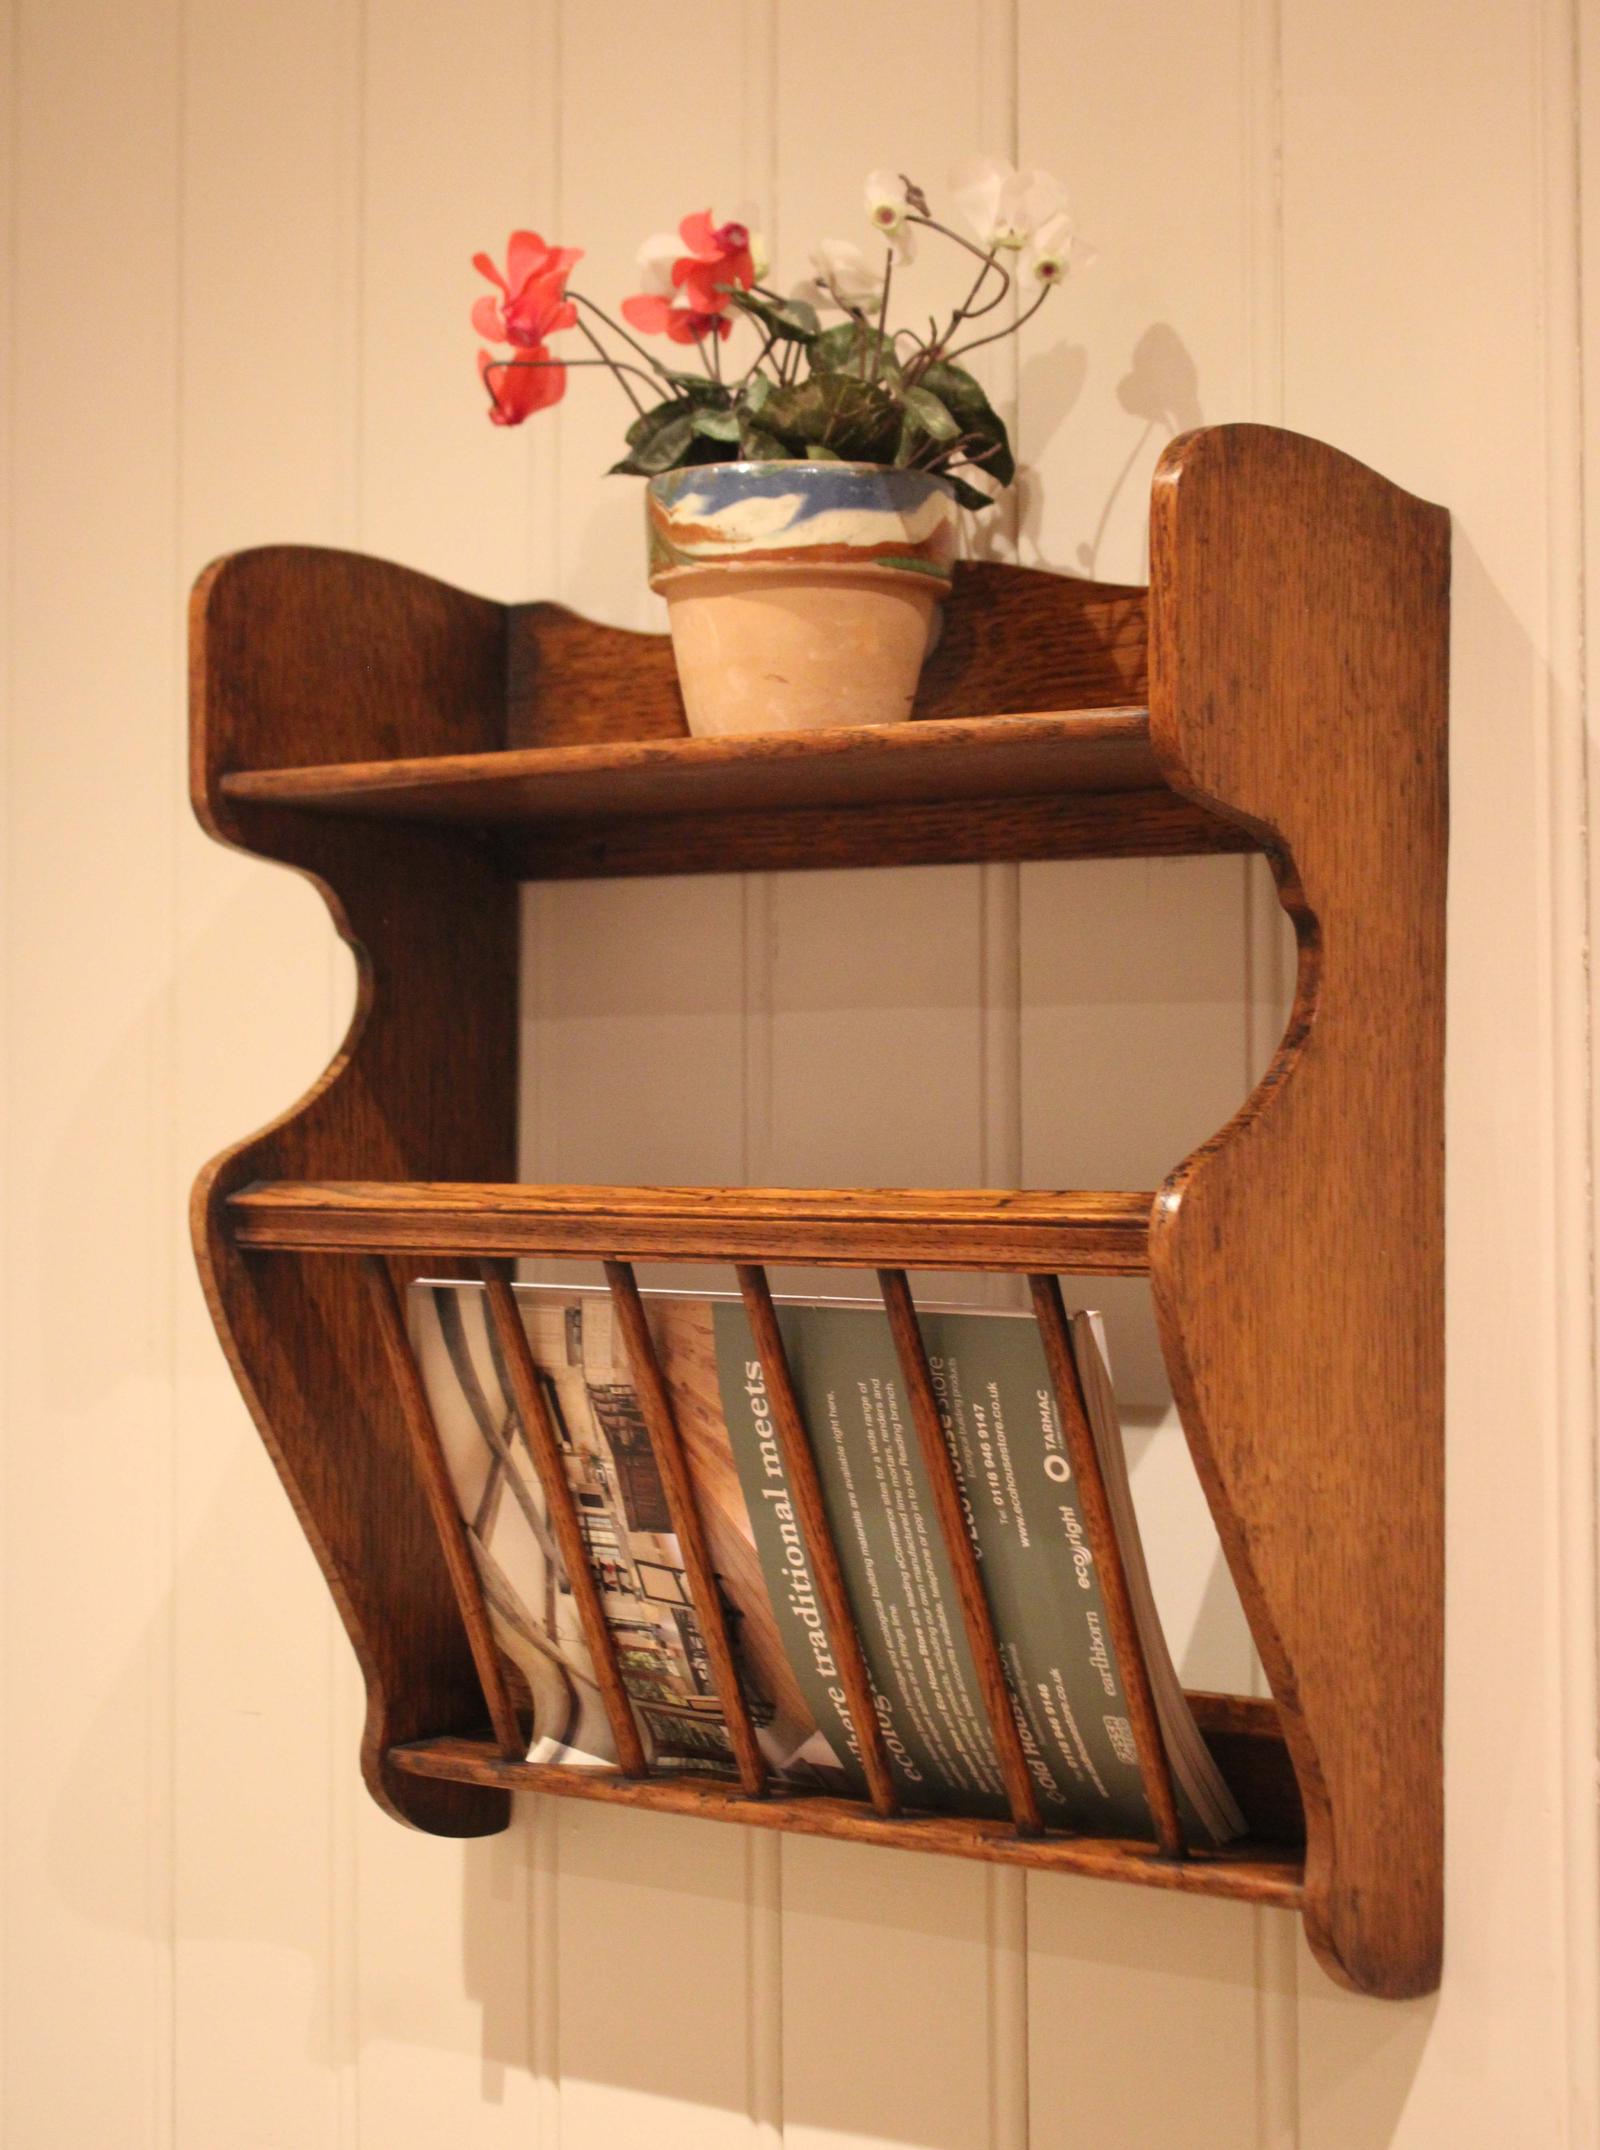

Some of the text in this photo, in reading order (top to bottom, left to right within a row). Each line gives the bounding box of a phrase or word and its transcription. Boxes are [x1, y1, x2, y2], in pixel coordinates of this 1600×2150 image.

[856, 1382, 868, 1394] of
[870, 1378, 882, 1400] and
[948, 1357, 963, 1398] products
[861, 1396, 873, 1427] range
[876, 1402, 890, 1442] renders
[954, 1398, 968, 1435] building
[972, 1403, 989, 1438] 9147
[1036, 1389, 1053, 1450] TARMAC
[830, 1419, 844, 1444] right
[866, 1429, 878, 1454] wide
[892, 1423, 909, 1466] Reading
[836, 1445, 854, 1490] available
[875, 1464, 885, 1480] for
[980, 1442, 995, 1468] 946
[986, 1382, 1031, 1547] www.ecohousestore.co.uk
[848, 1492, 858, 1509] are
[879, 1482, 891, 1506] sites
[894, 1490, 906, 1511] lime
[986, 1471, 1004, 1506] 0118
[852, 1511, 870, 1556] materials
[886, 1508, 906, 1569] eCommerce
[913, 1512, 927, 1534] pop
[743, 1359, 862, 1764] here traditional meets
[898, 1512, 923, 1582] manufactured
[864, 1558, 880, 1598] building
[900, 1571, 916, 1608] leading
[922, 1548, 940, 1598] telephone
[917, 1584, 929, 1606] own
[872, 1599, 894, 1648] ecological
[910, 1609, 921, 1626] are
[923, 1607, 934, 1624] our
[915, 1627, 928, 1656] Store
[928, 1626, 946, 1670] including
[1085, 1610, 1117, 1697] earthborn
[923, 1657, 939, 1690] House
[946, 1648, 966, 1692] accounts
[934, 1692, 947, 1710] Eco
[1026, 1759, 1057, 1789] Old
